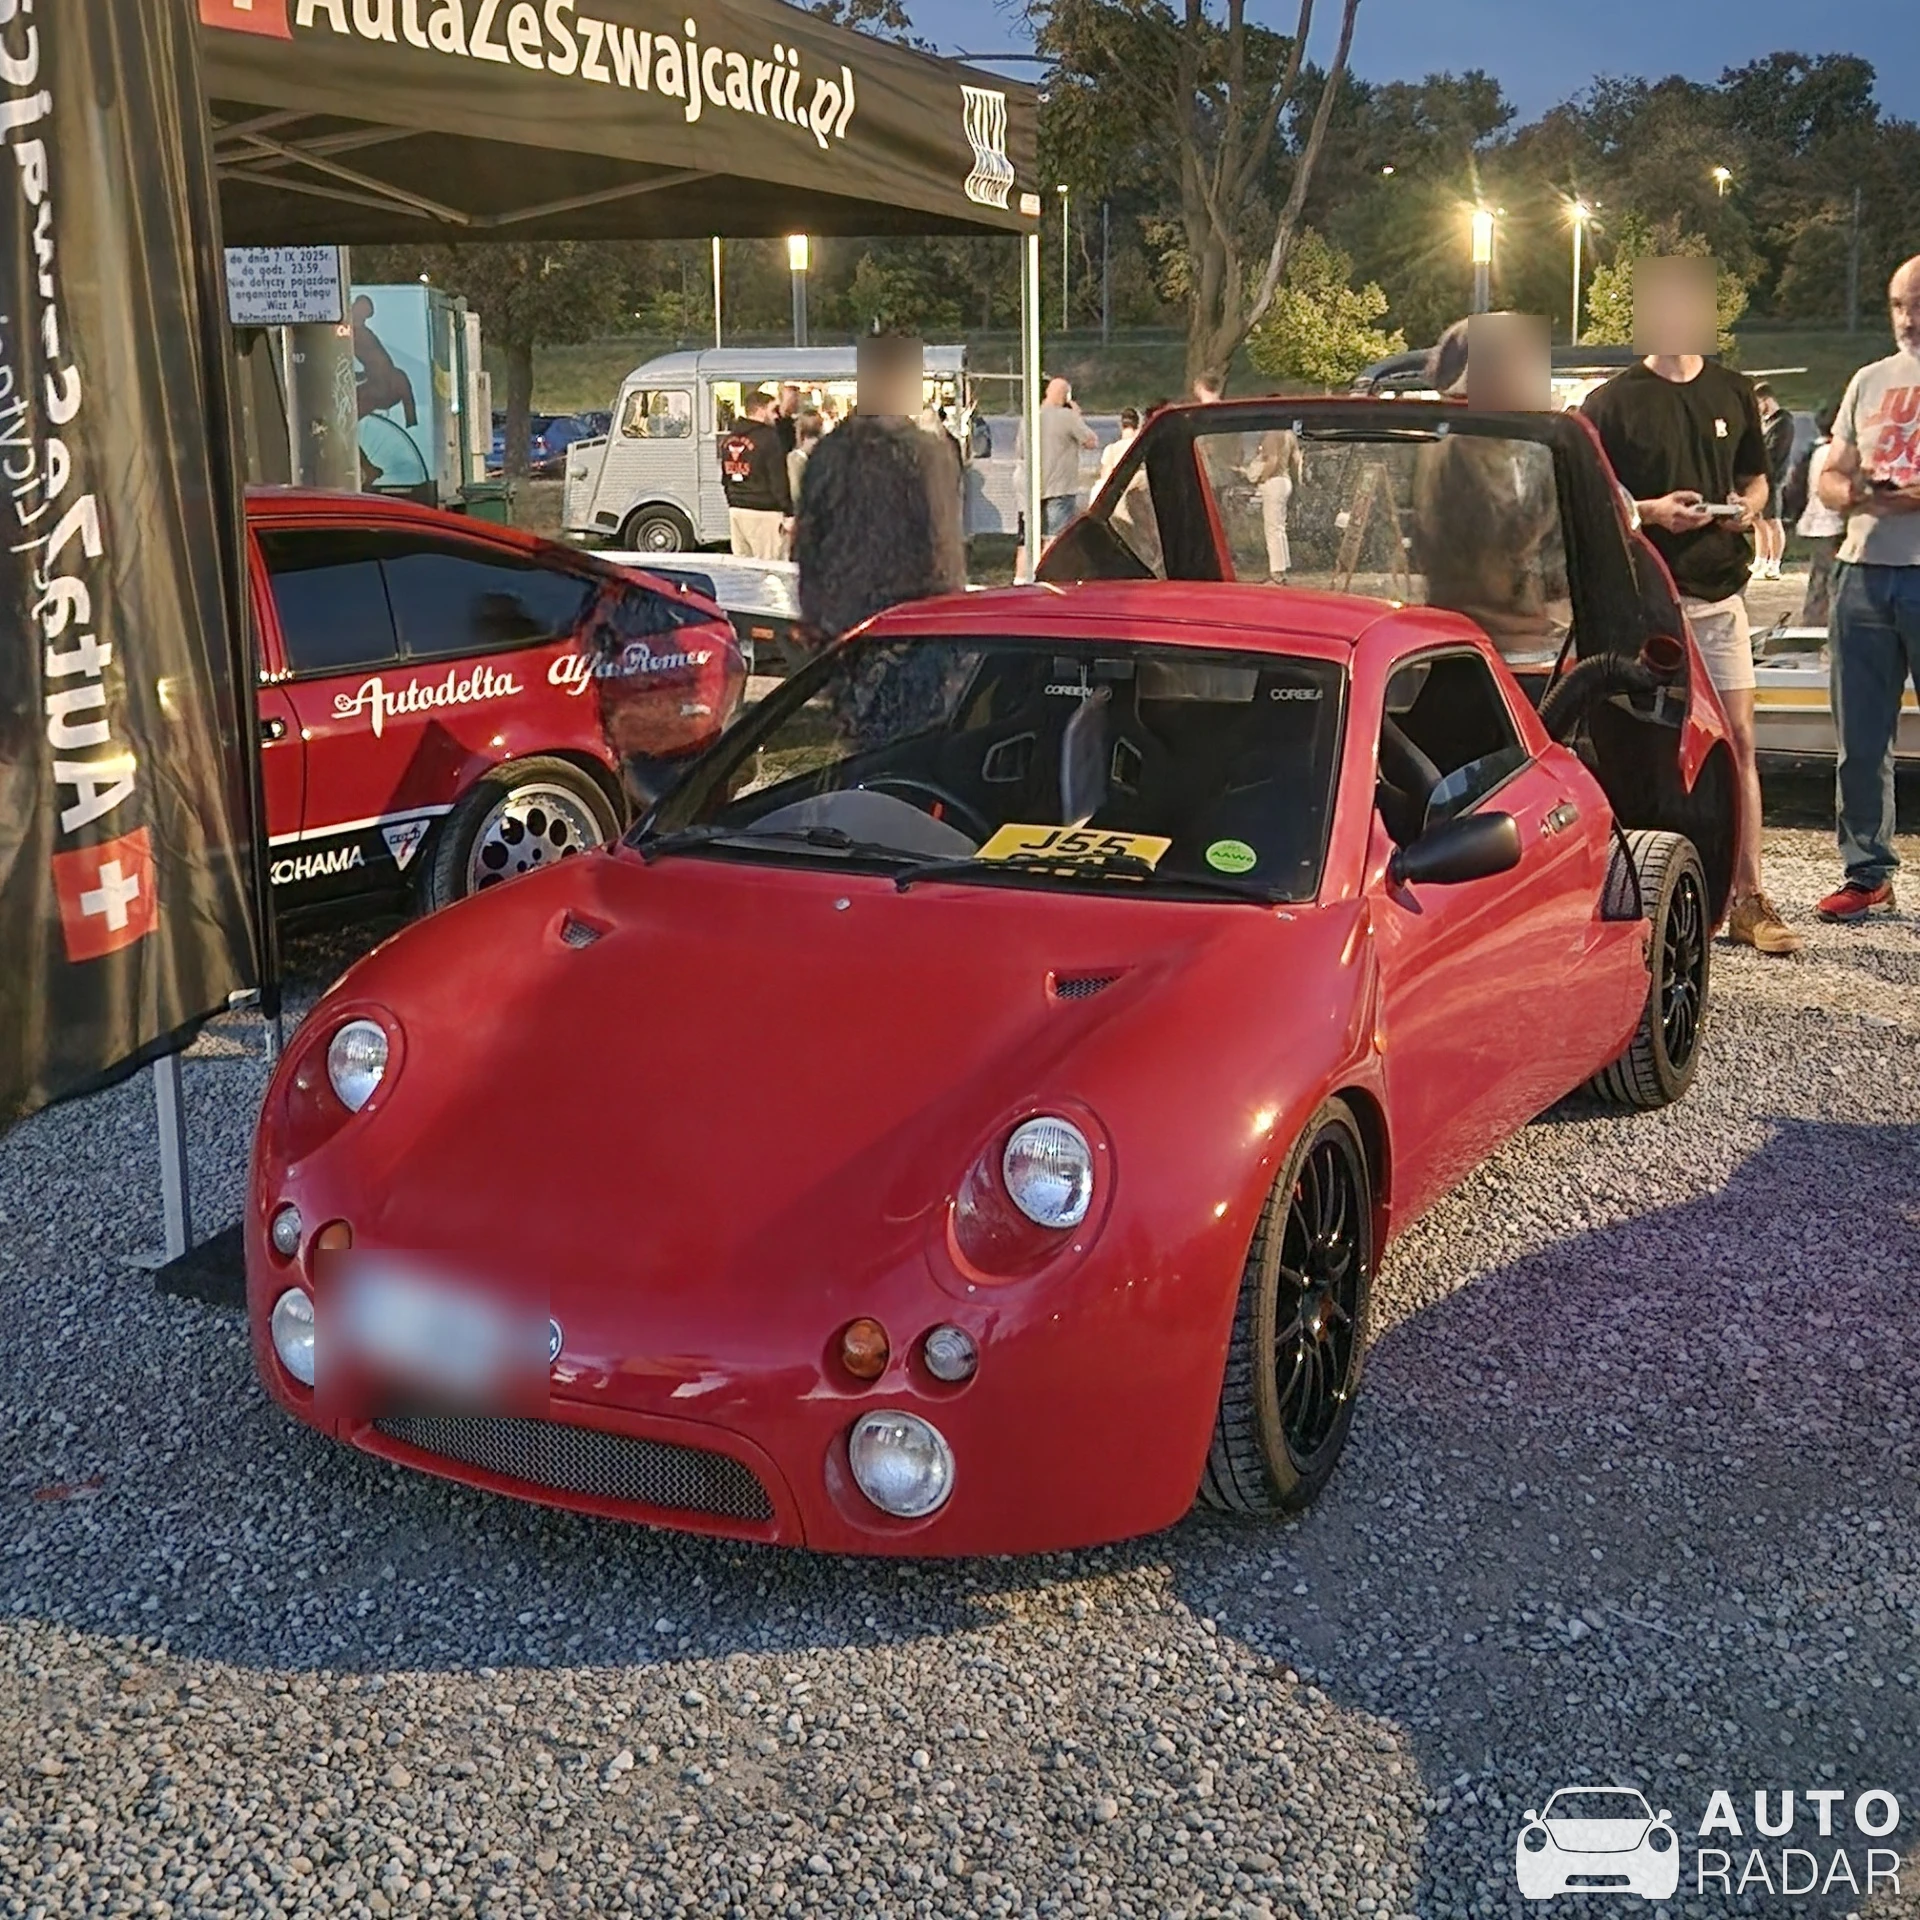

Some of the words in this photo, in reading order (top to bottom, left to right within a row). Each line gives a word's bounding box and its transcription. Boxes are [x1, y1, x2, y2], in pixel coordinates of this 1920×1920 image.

[297, 0, 855, 148] AutaZeSzwajcarii.pl
[230, 254, 242, 264] do
[248, 253, 269, 263] dnia
[274, 252, 280, 262] 7
[284, 251, 295, 262] IX
[242, 266, 254, 275] do
[228, 278, 244, 287] Nie
[250, 277, 285, 289] dotyczy
[236, 288, 298, 302] organizatora
[303, 287, 331, 300] biegu
[293, 300, 306, 310] Air
[547, 651, 616, 696] Alfa
[622, 642, 712, 675] Romeo
[331, 665, 523, 738] Autodelta
[1020, 830, 1135, 856] J55
